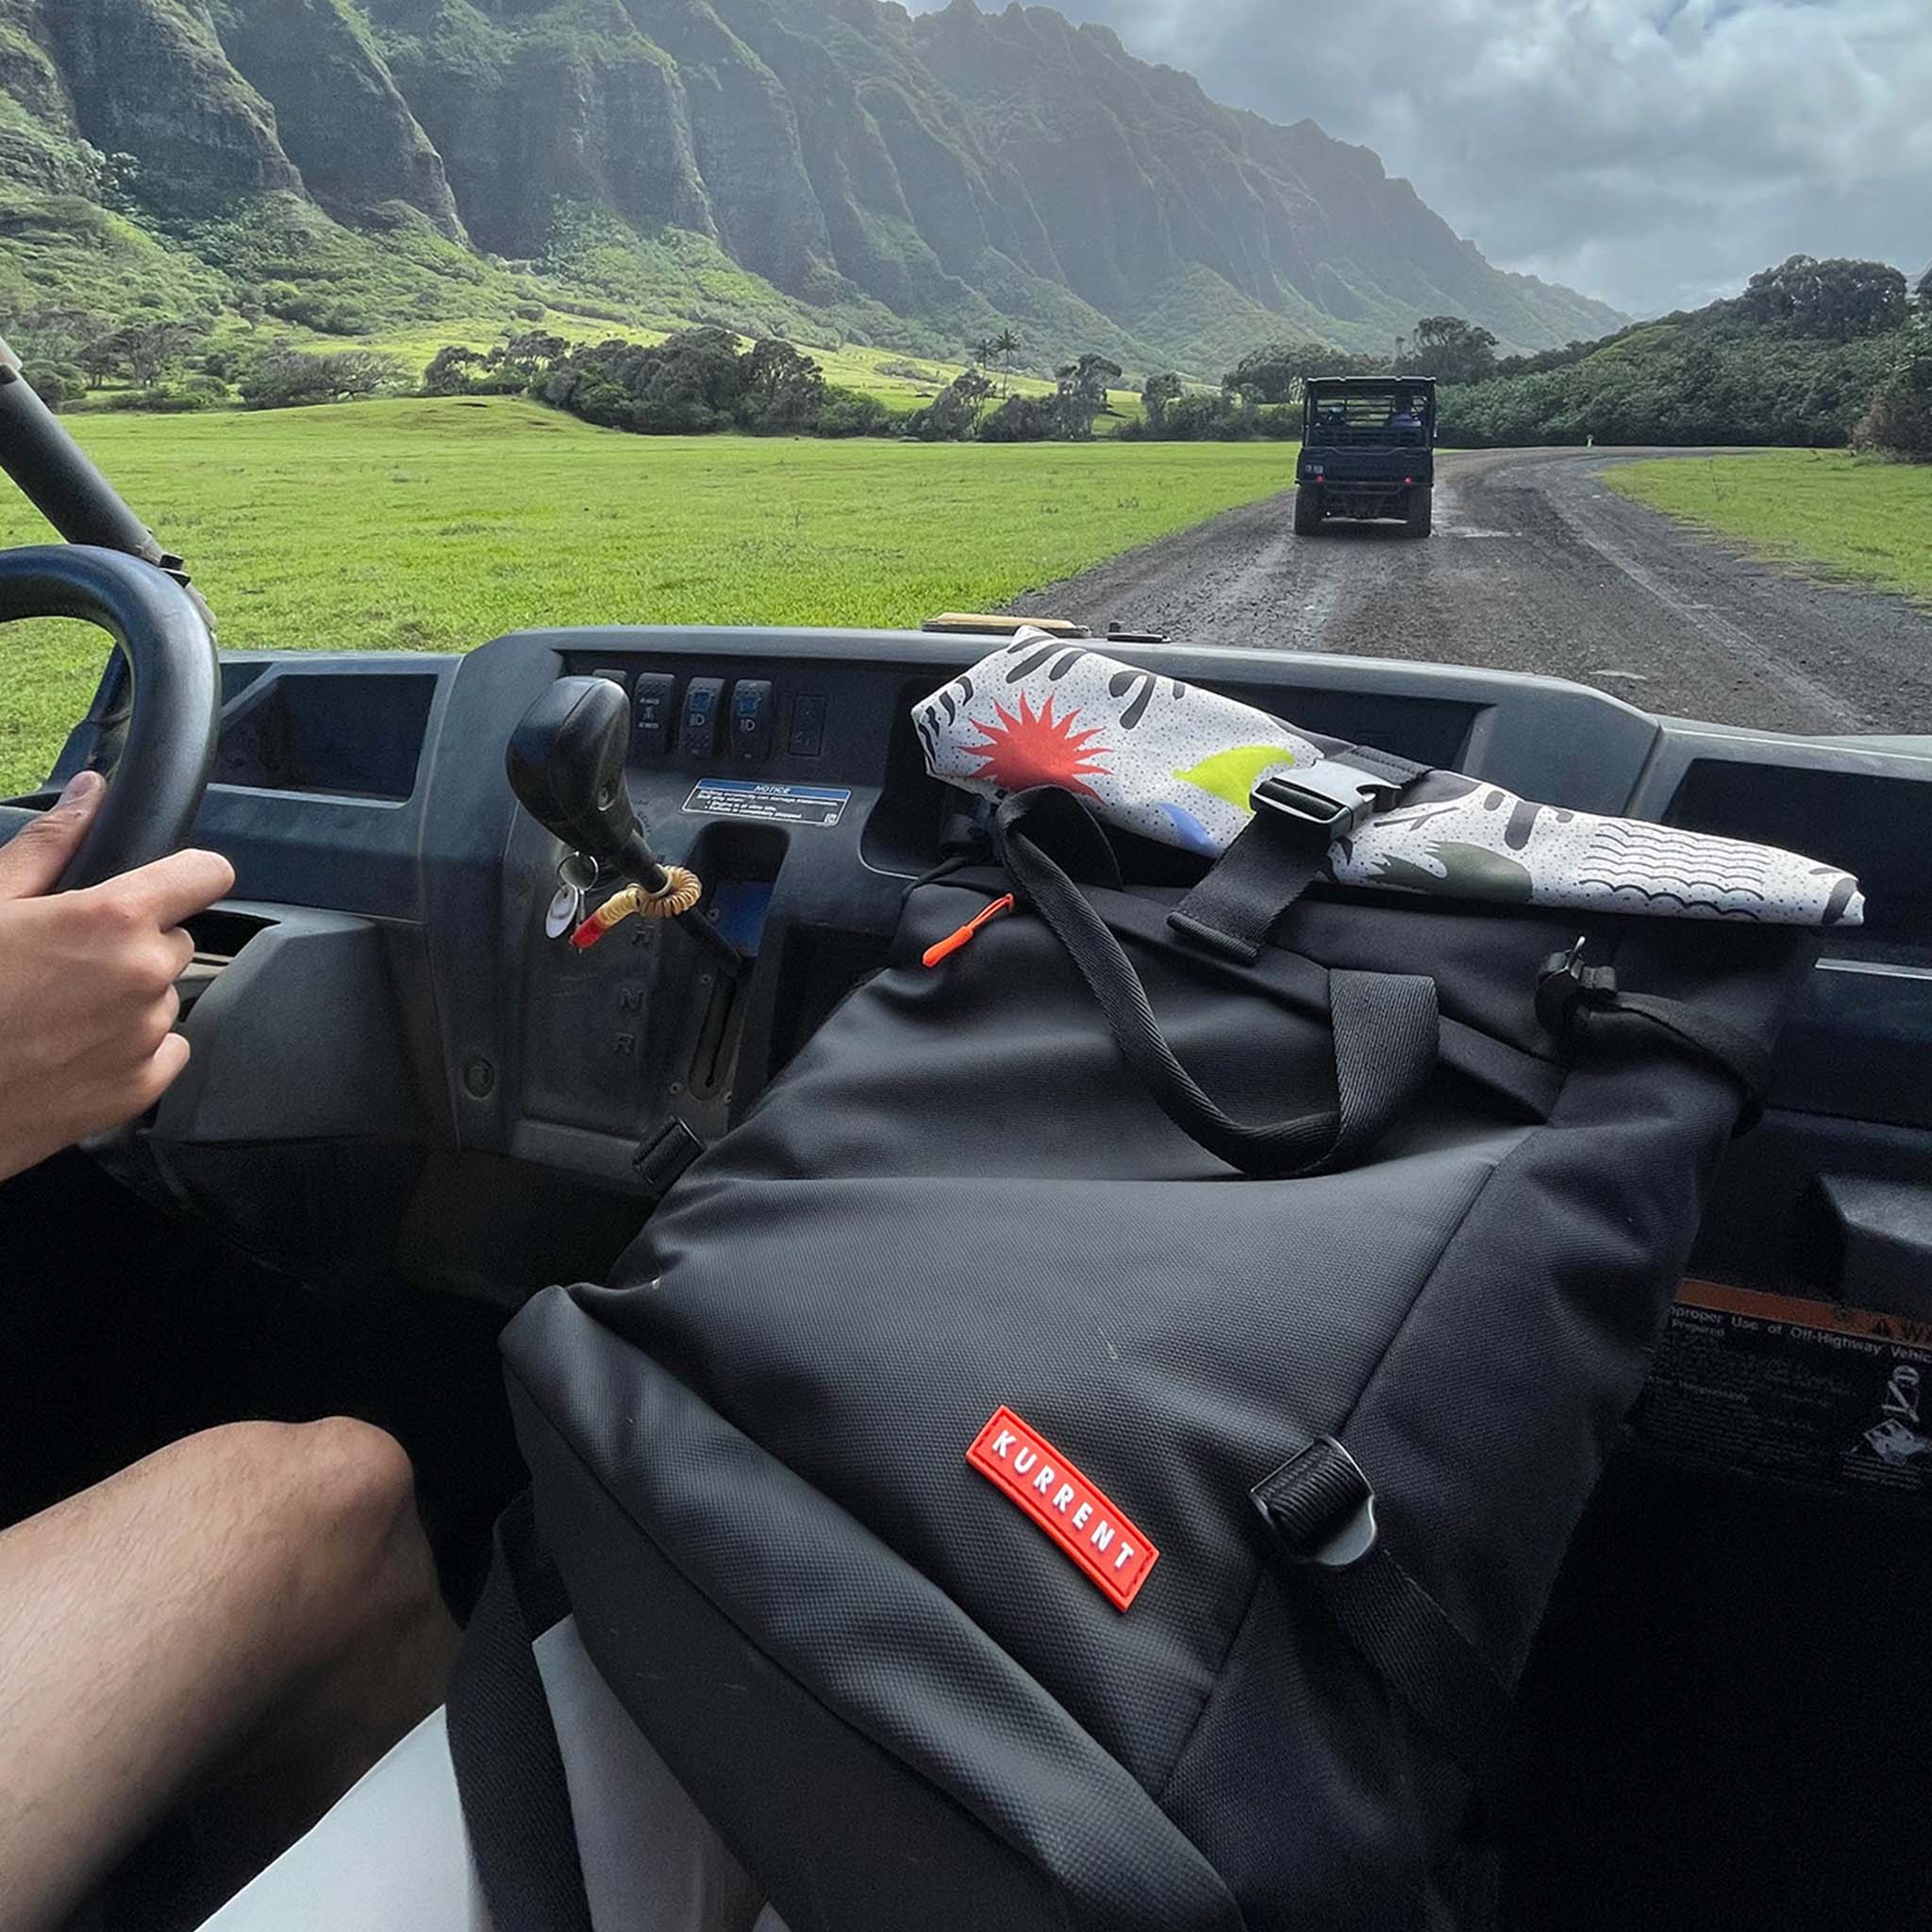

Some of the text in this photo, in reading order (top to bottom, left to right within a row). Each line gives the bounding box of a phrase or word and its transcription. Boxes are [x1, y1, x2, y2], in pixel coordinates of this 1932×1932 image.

[755, 784, 791, 794] NOTICE
[619, 987, 644, 1010] N
[613, 1031, 635, 1055] R
[1731, 1316, 1759, 1331] Use
[1768, 1324, 1782, 1335] of
[1790, 1326, 1882, 1356] Off-Highway
[991, 1428, 1134, 1570] KURRENT
